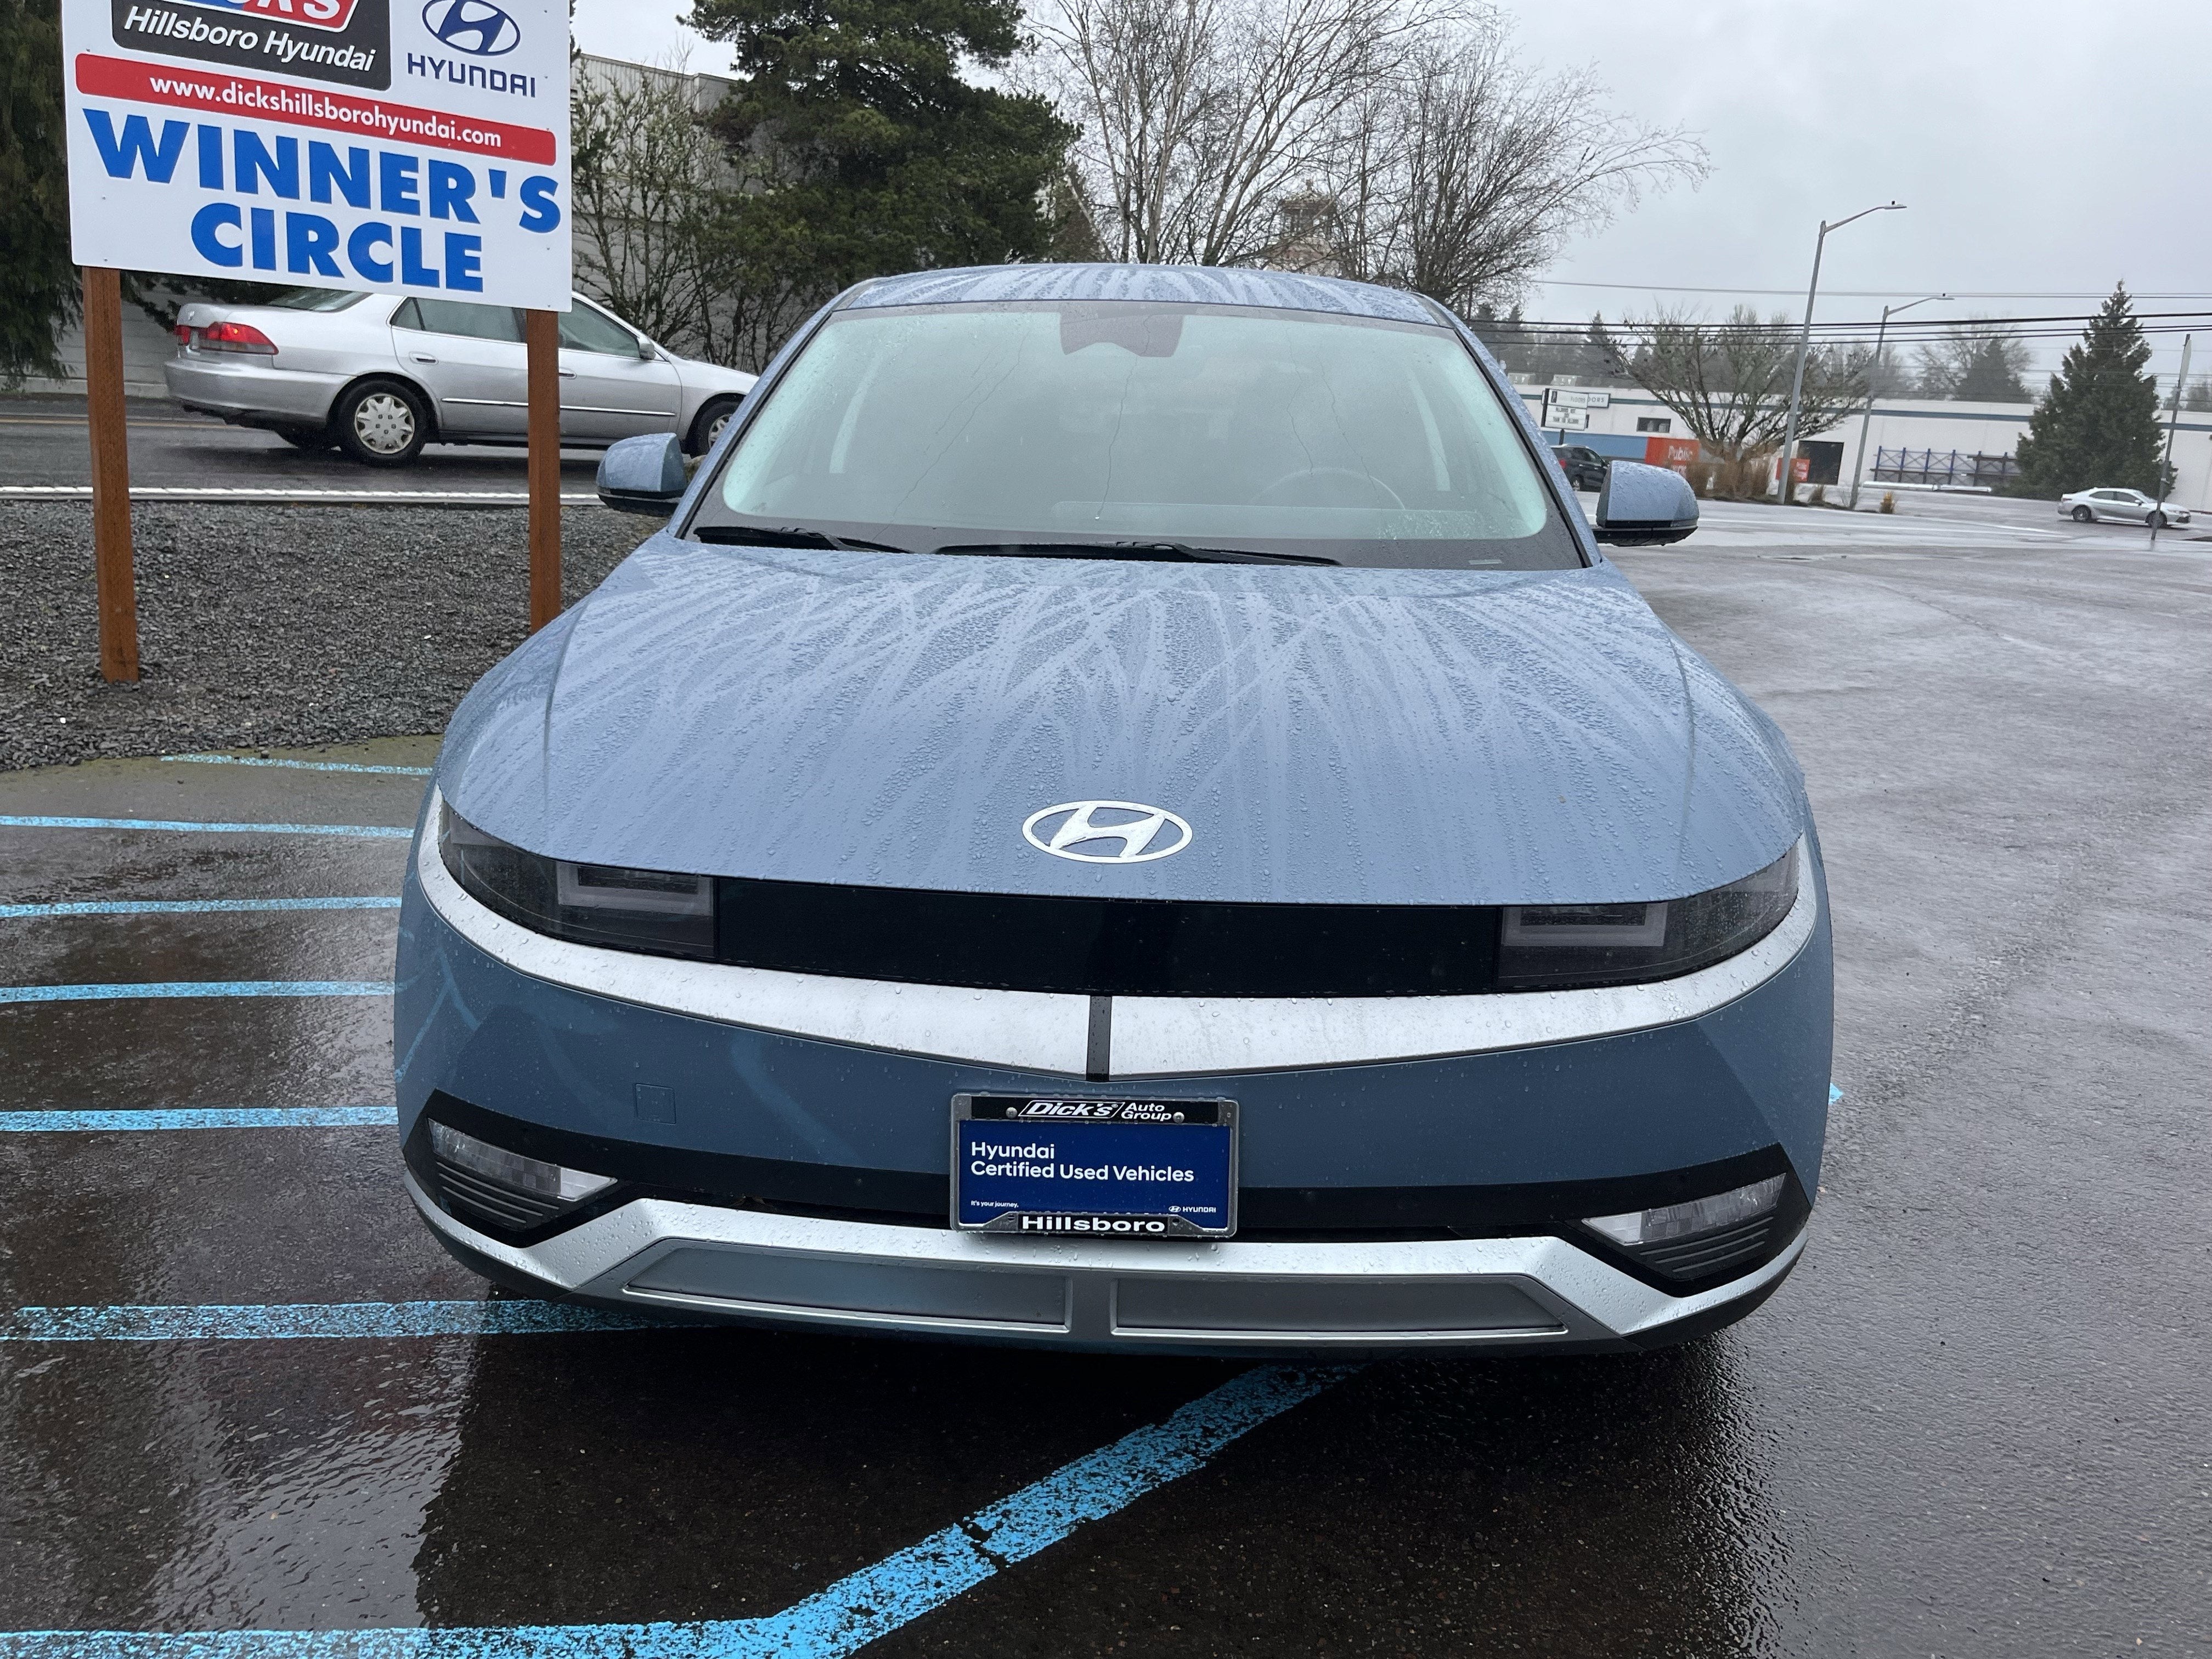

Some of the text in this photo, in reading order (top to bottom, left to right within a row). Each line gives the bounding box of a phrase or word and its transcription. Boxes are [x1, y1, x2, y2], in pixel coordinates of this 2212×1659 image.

[123, 5, 258, 50] Hillsboro
[263, 31, 376, 72] Hyundai
[408, 53, 535, 98] HYUNDAI
[150, 77, 501, 147] www.dickshillsborohyundai.com
[82, 108, 561, 233] WINNER'S
[191, 202, 483, 294] CIRCLE
[1026, 1102, 1113, 1116] Dick's
[1121, 1111, 1172, 1121] Group
[1125, 1102, 1165, 1112] Auto
[971, 1142, 1054, 1159] Hyundai
[971, 1160, 1194, 1182] Certified Used Vehicles
[1022, 1216, 1165, 1232] Hillsboro
